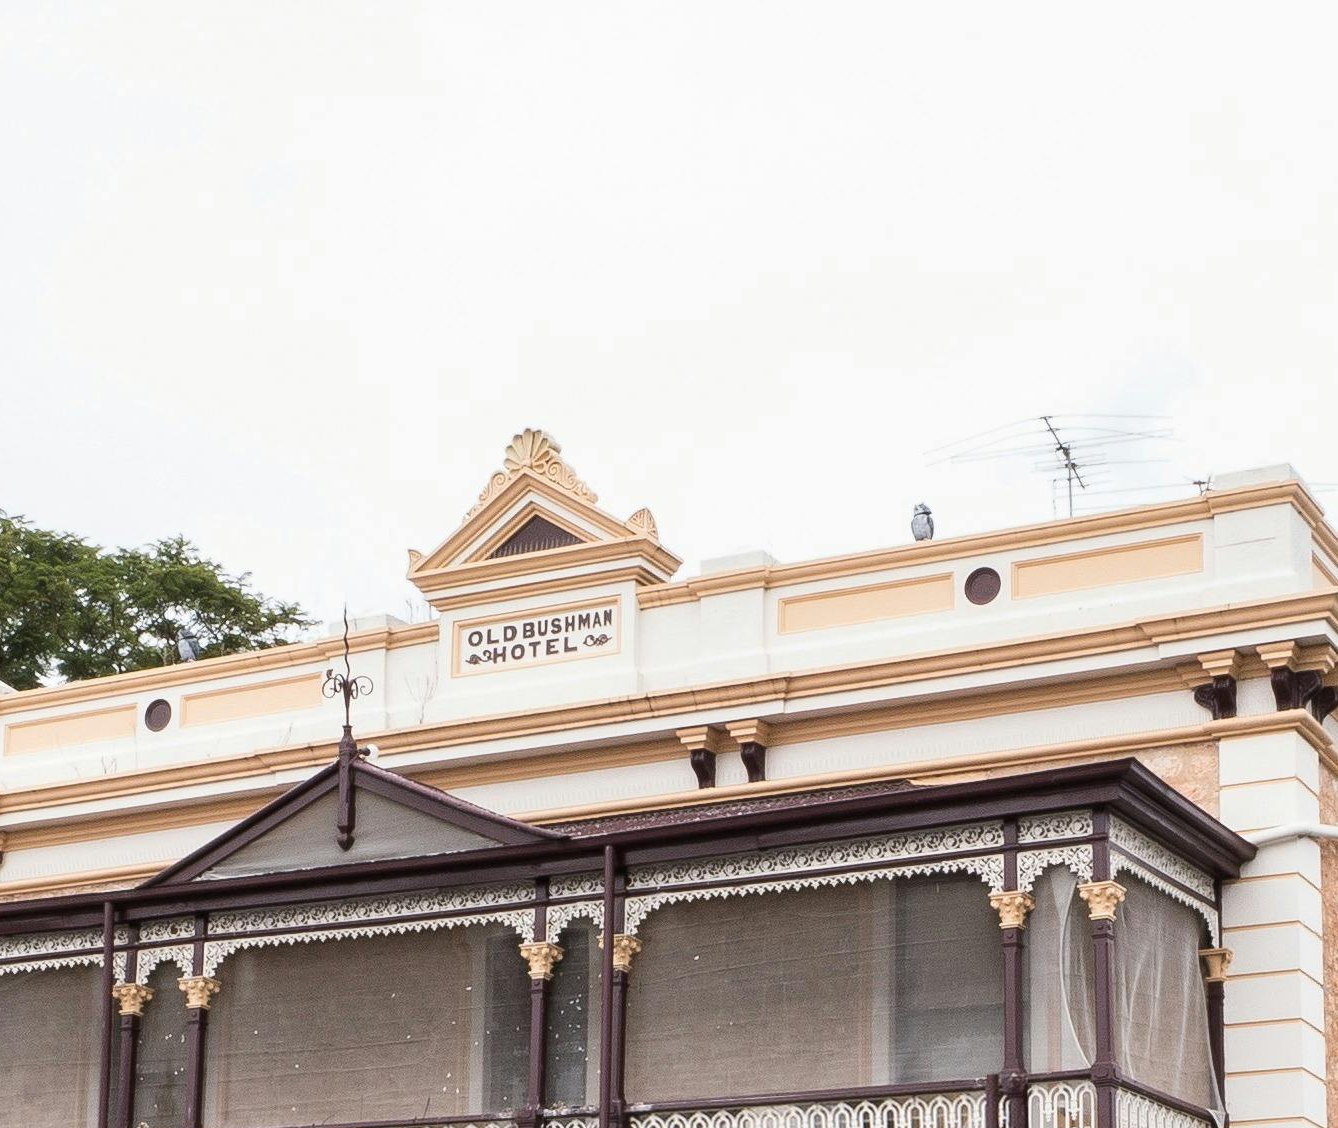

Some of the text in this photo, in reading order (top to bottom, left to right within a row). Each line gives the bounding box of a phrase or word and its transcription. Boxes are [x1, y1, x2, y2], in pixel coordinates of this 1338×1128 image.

[467, 609, 612, 647] OLD BUSHMAN
[493, 637, 578, 664] HOTEL
